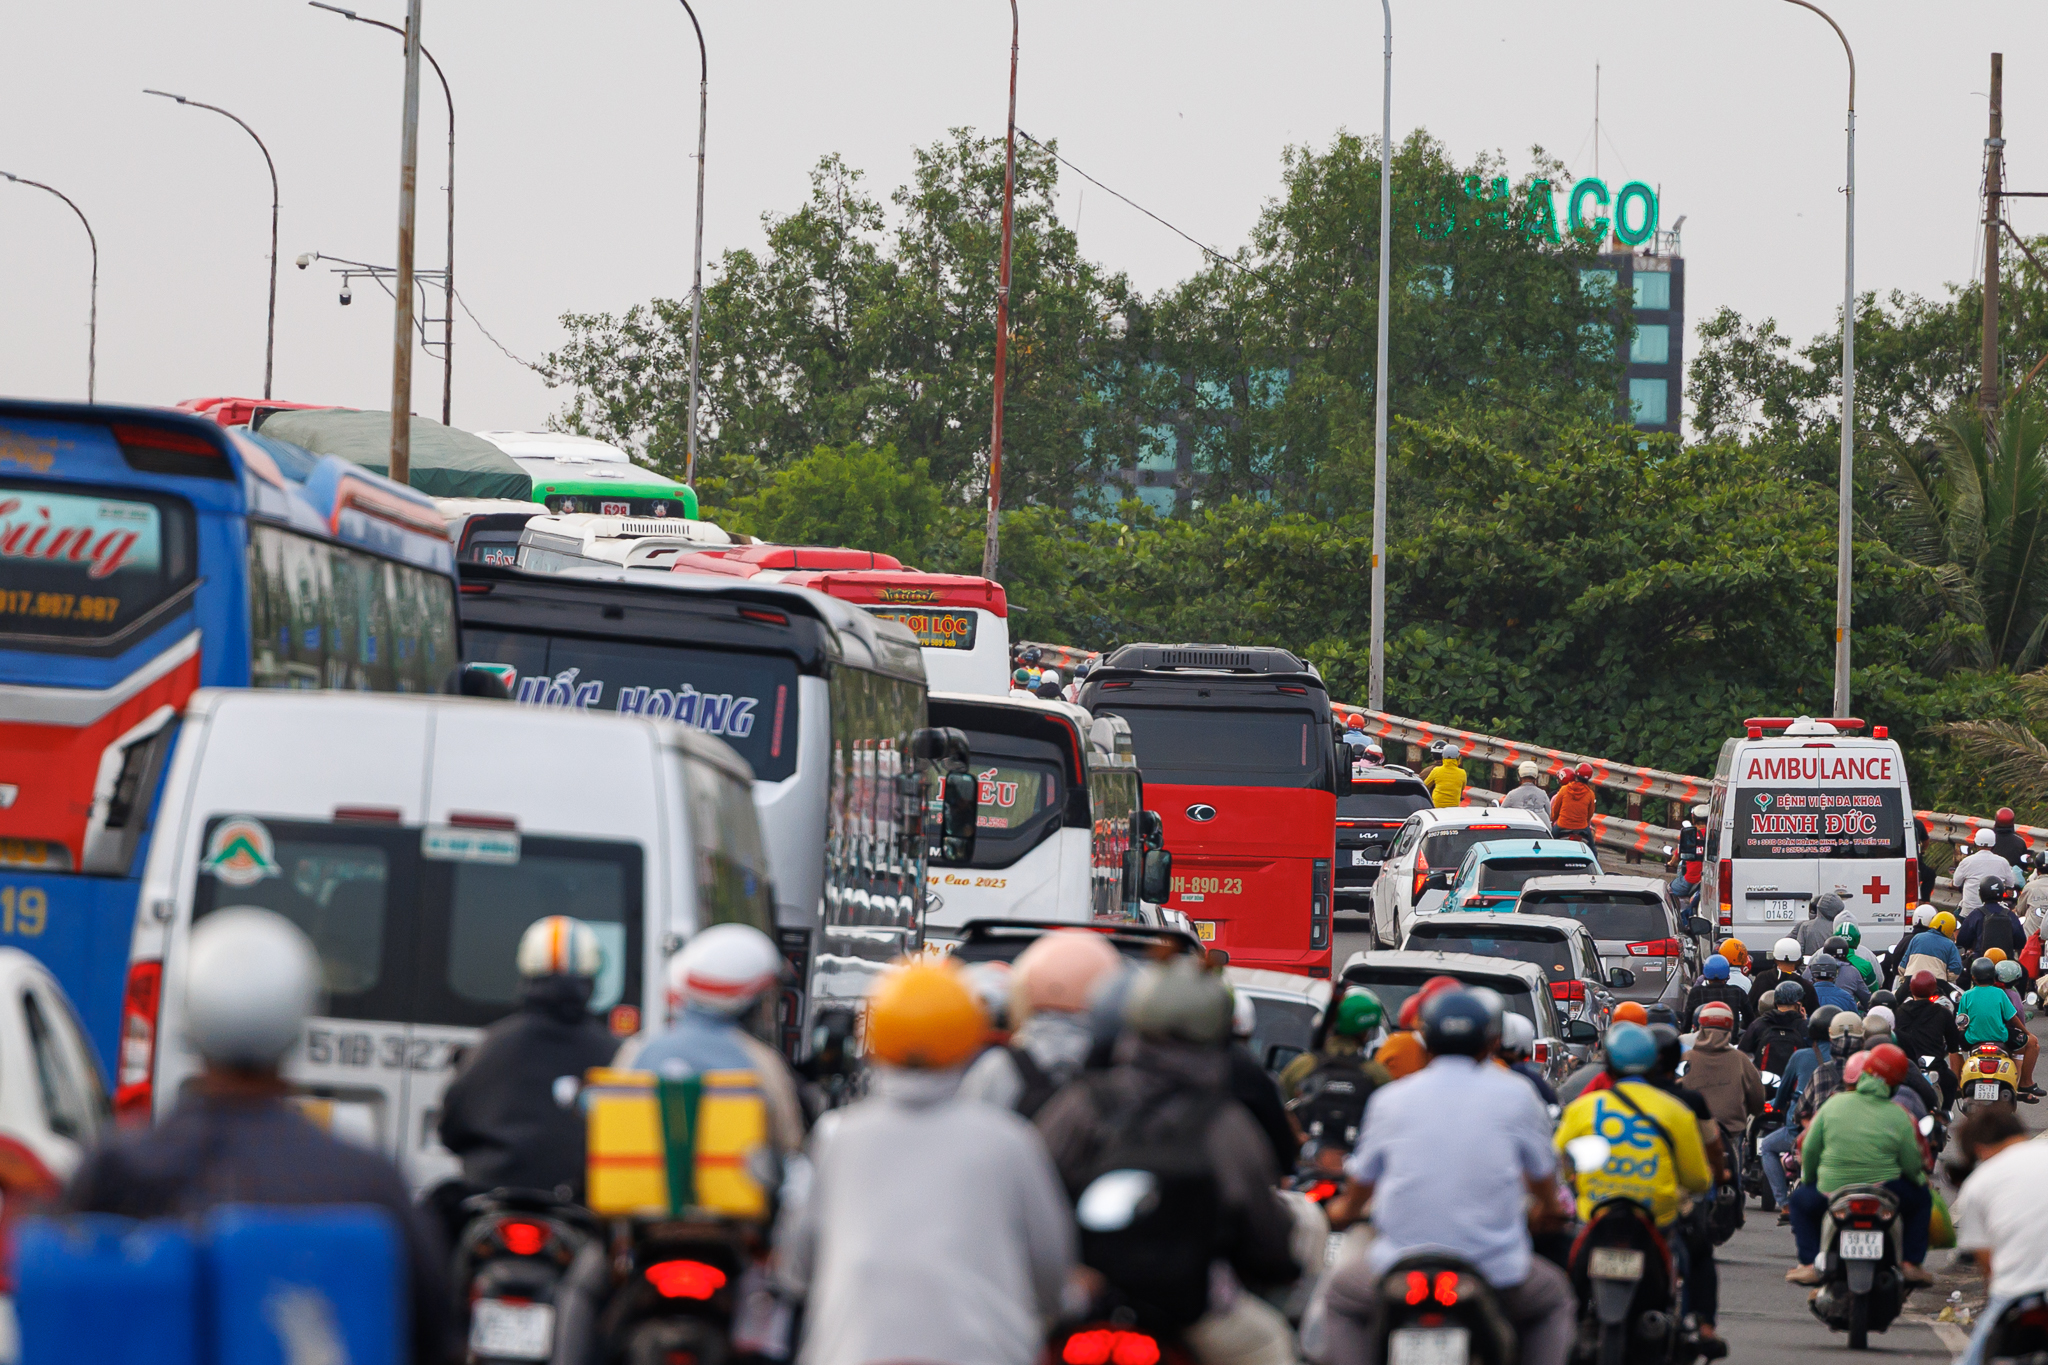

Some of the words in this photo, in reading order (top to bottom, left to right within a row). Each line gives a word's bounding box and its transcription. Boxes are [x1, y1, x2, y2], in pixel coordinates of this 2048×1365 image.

[932, 614, 968, 638] LỘC
[616, 683, 759, 738] HOÀNG
[1747, 757, 1892, 780] AMBULANCE
[1777, 793, 1806, 810] BỆNH
[1808, 793, 1834, 810] VIỆN
[1836, 796, 1851, 807] ĐA
[1853, 796, 1882, 807] KHOA
[1751, 813, 1819, 834] MINH
[1825, 809, 1877, 834] ĐỨC
[975, 876, 1007, 889] 2025
[1766, 910, 1794, 920] 014.62
[1772, 900, 1788, 910] 71B
[1594, 1097, 1661, 1150] be
